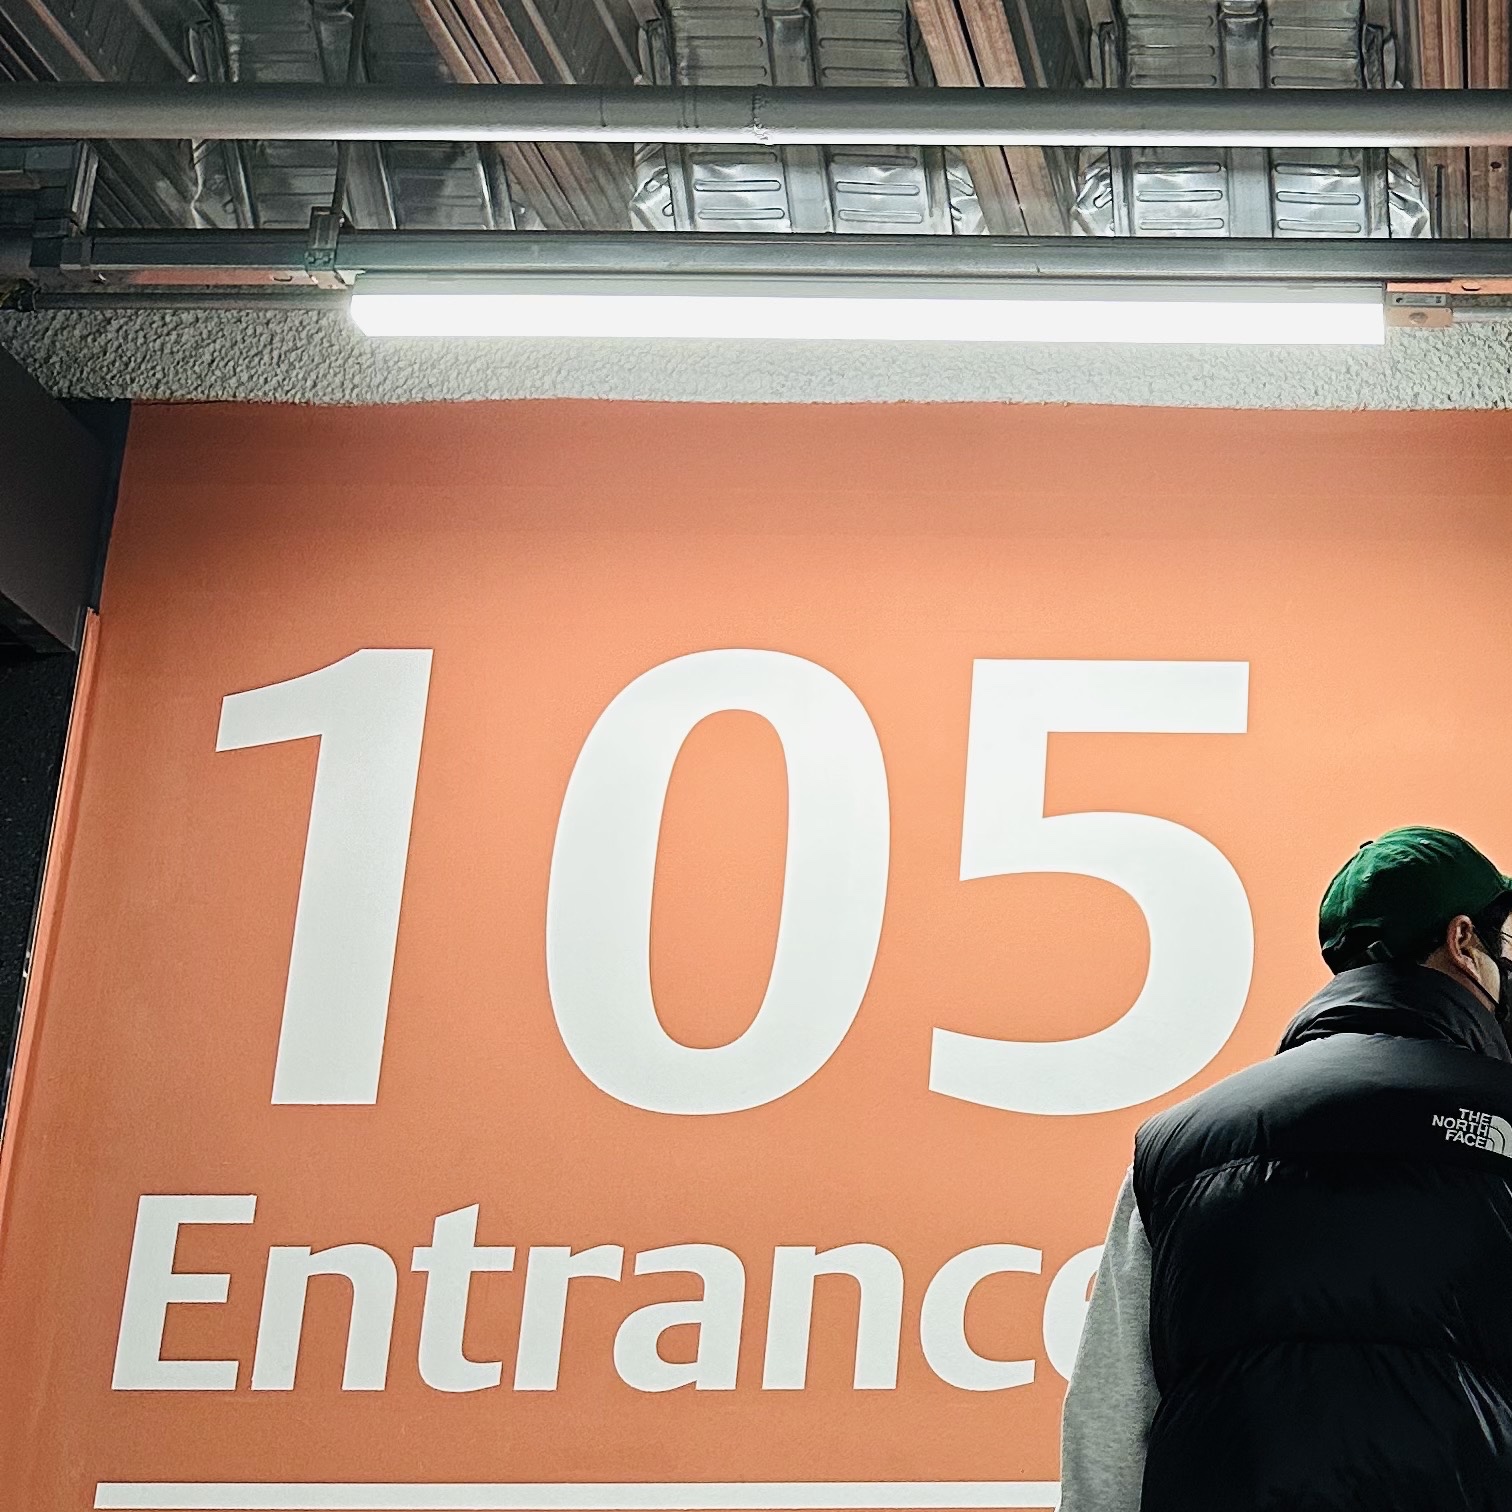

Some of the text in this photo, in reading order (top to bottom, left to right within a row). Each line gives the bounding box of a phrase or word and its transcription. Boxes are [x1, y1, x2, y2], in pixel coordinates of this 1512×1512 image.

[216, 648, 1255, 1115] 105
[1432, 1114, 1490, 1137] NORTH
[1459, 1108, 1491, 1123] THE
[1445, 1129, 1488, 1149] FACE
